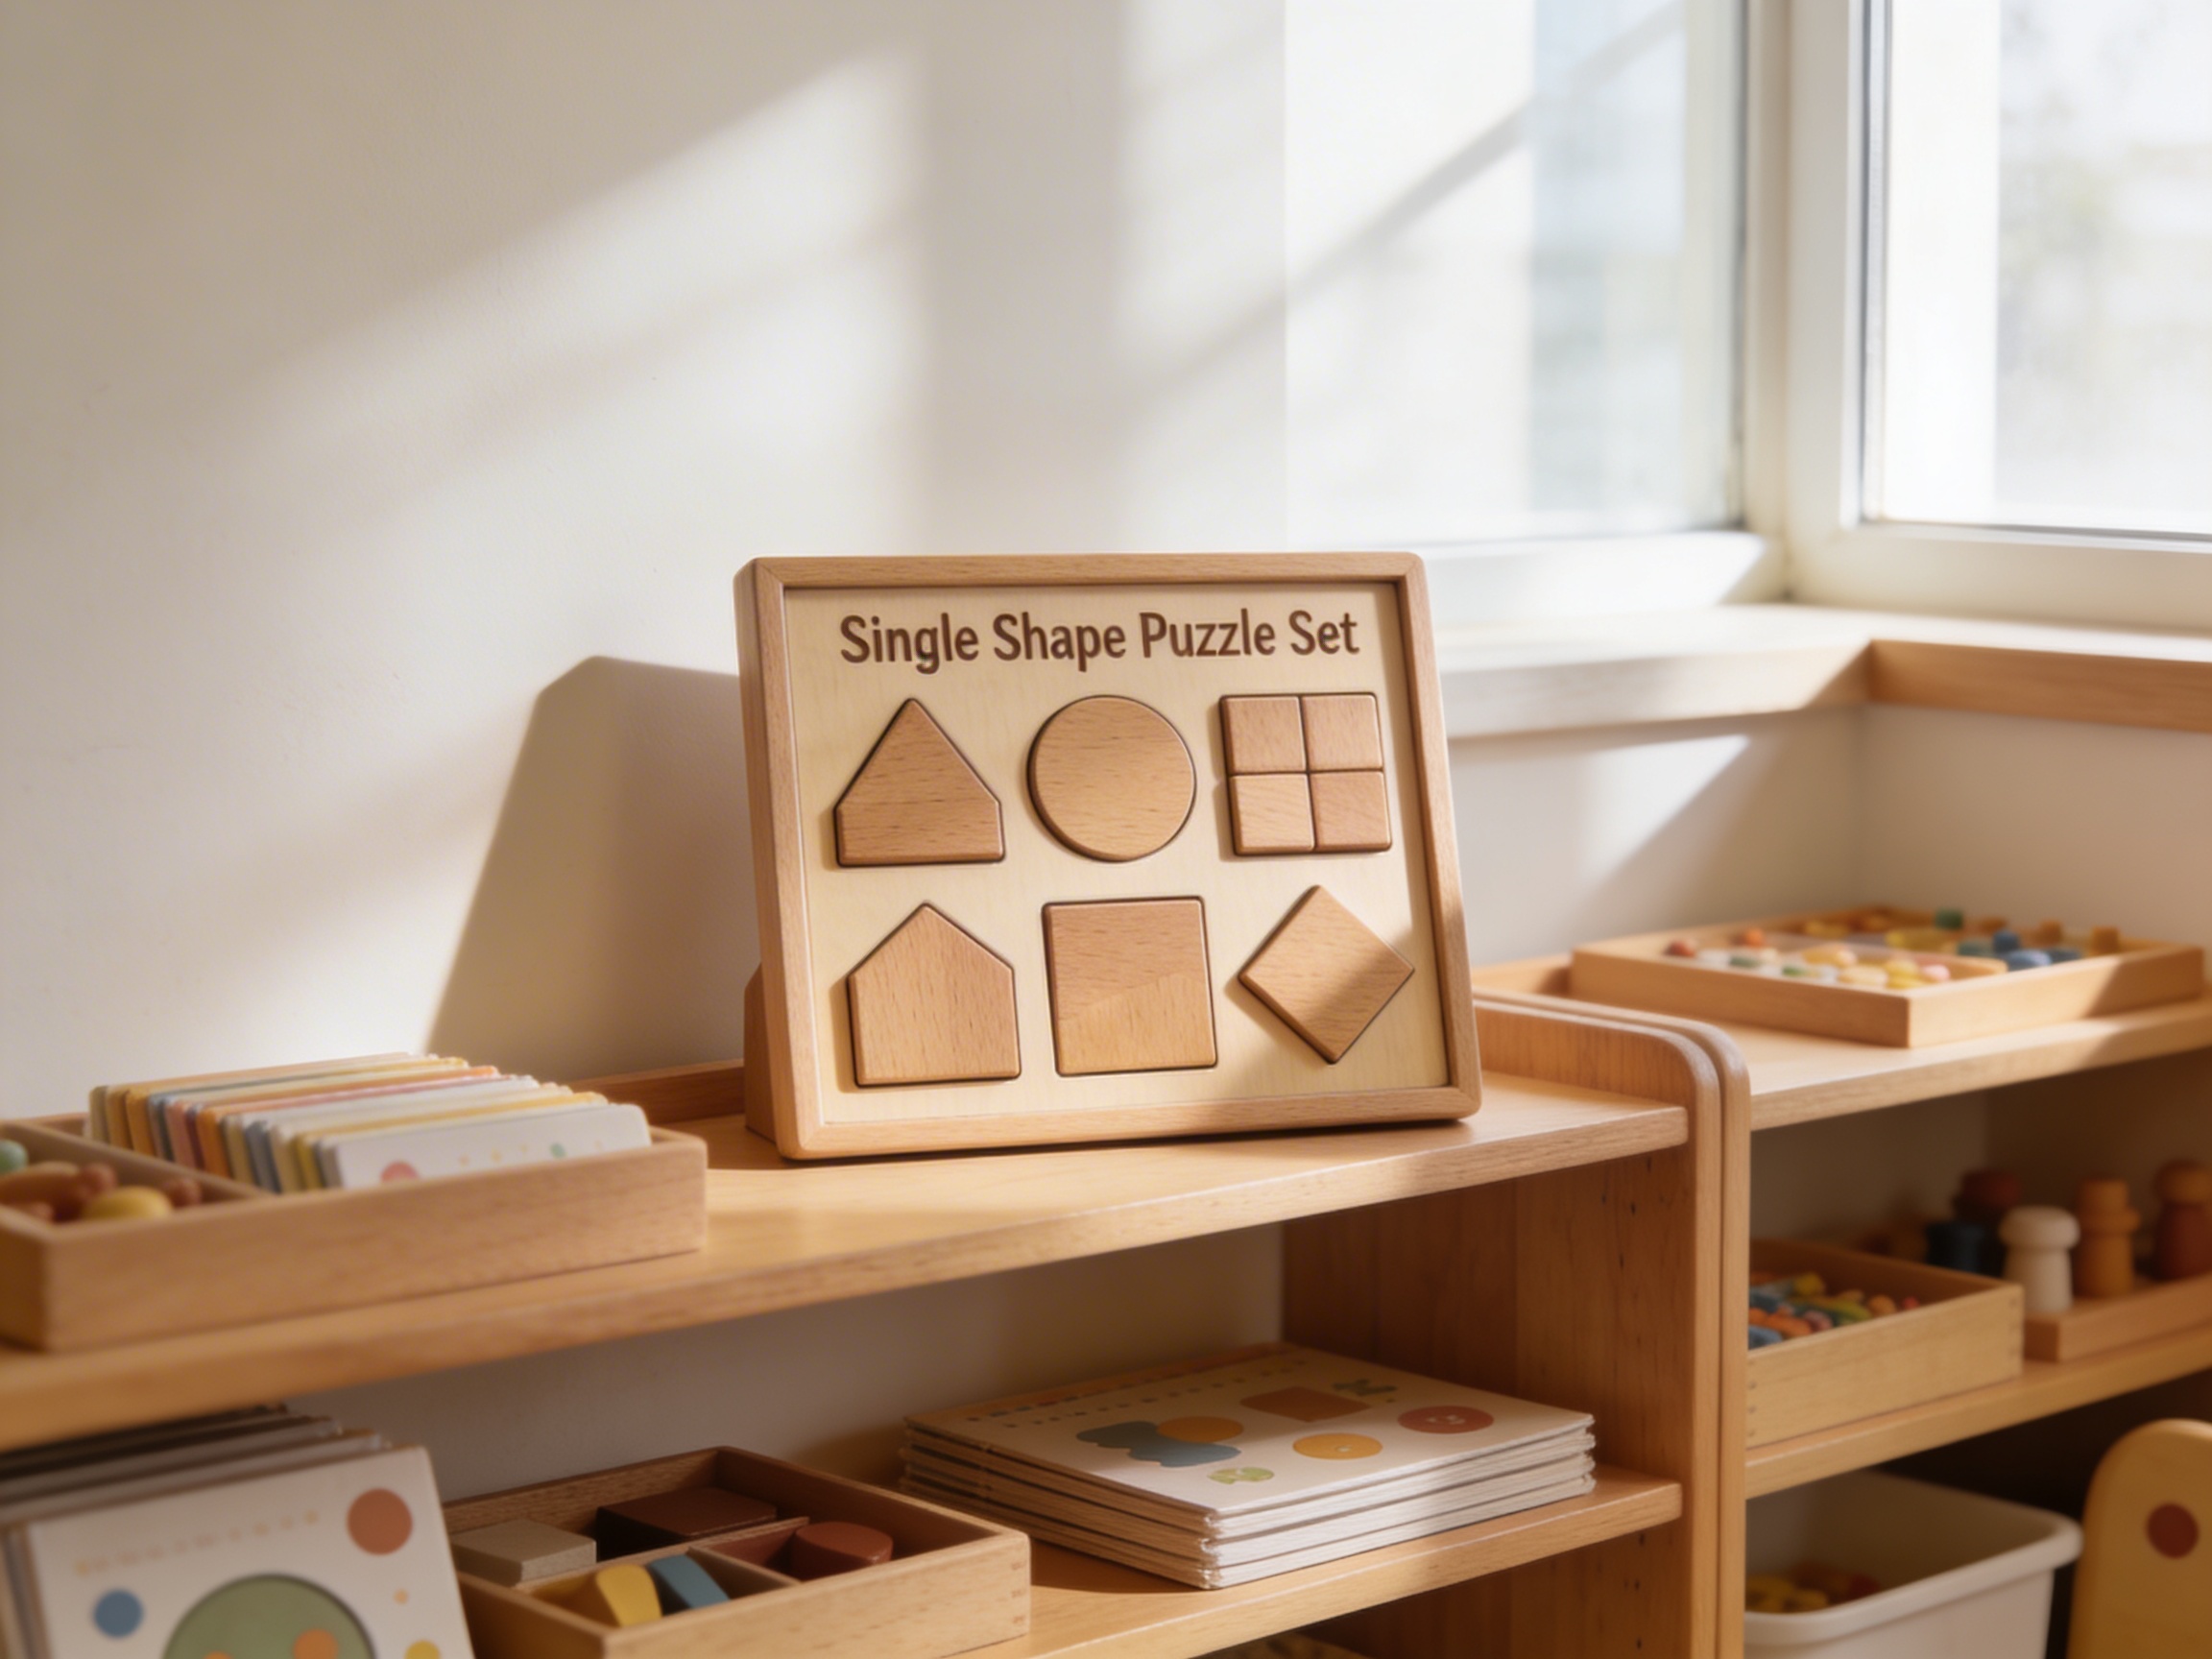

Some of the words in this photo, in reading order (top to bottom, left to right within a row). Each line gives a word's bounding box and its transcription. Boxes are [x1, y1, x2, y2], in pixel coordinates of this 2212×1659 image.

[840, 612, 980, 674] Single
[992, 611, 1126, 673] Shape
[1139, 609, 1276, 660] Puzzle
[1287, 610, 1360, 656] Set
